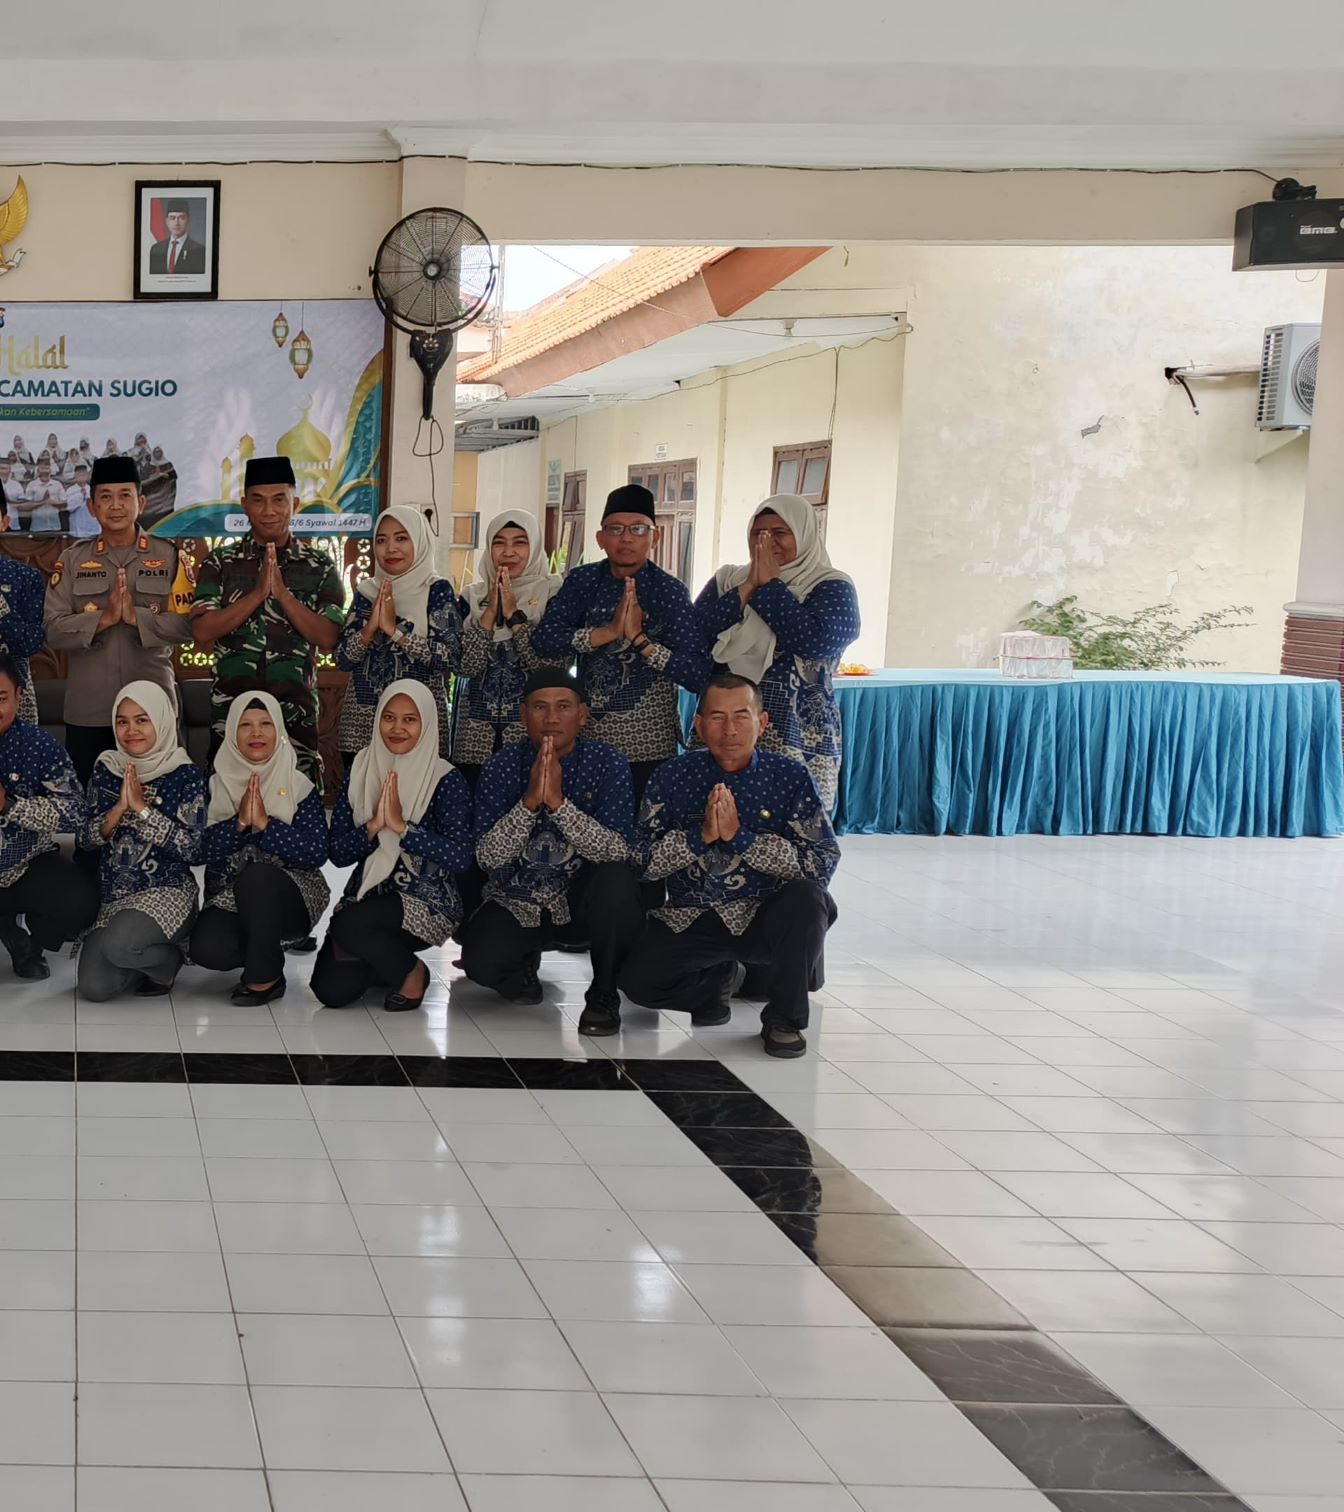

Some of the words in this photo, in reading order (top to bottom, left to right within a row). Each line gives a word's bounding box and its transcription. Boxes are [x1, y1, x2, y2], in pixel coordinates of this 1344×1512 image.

[109, 379, 178, 398] SUGIO
[233, 519, 245, 527] 26
[305, 518, 337, 528] Syawal
[338, 519, 358, 527] 1447
[358, 518, 367, 526] H
[138, 569, 169, 577] POLRI
